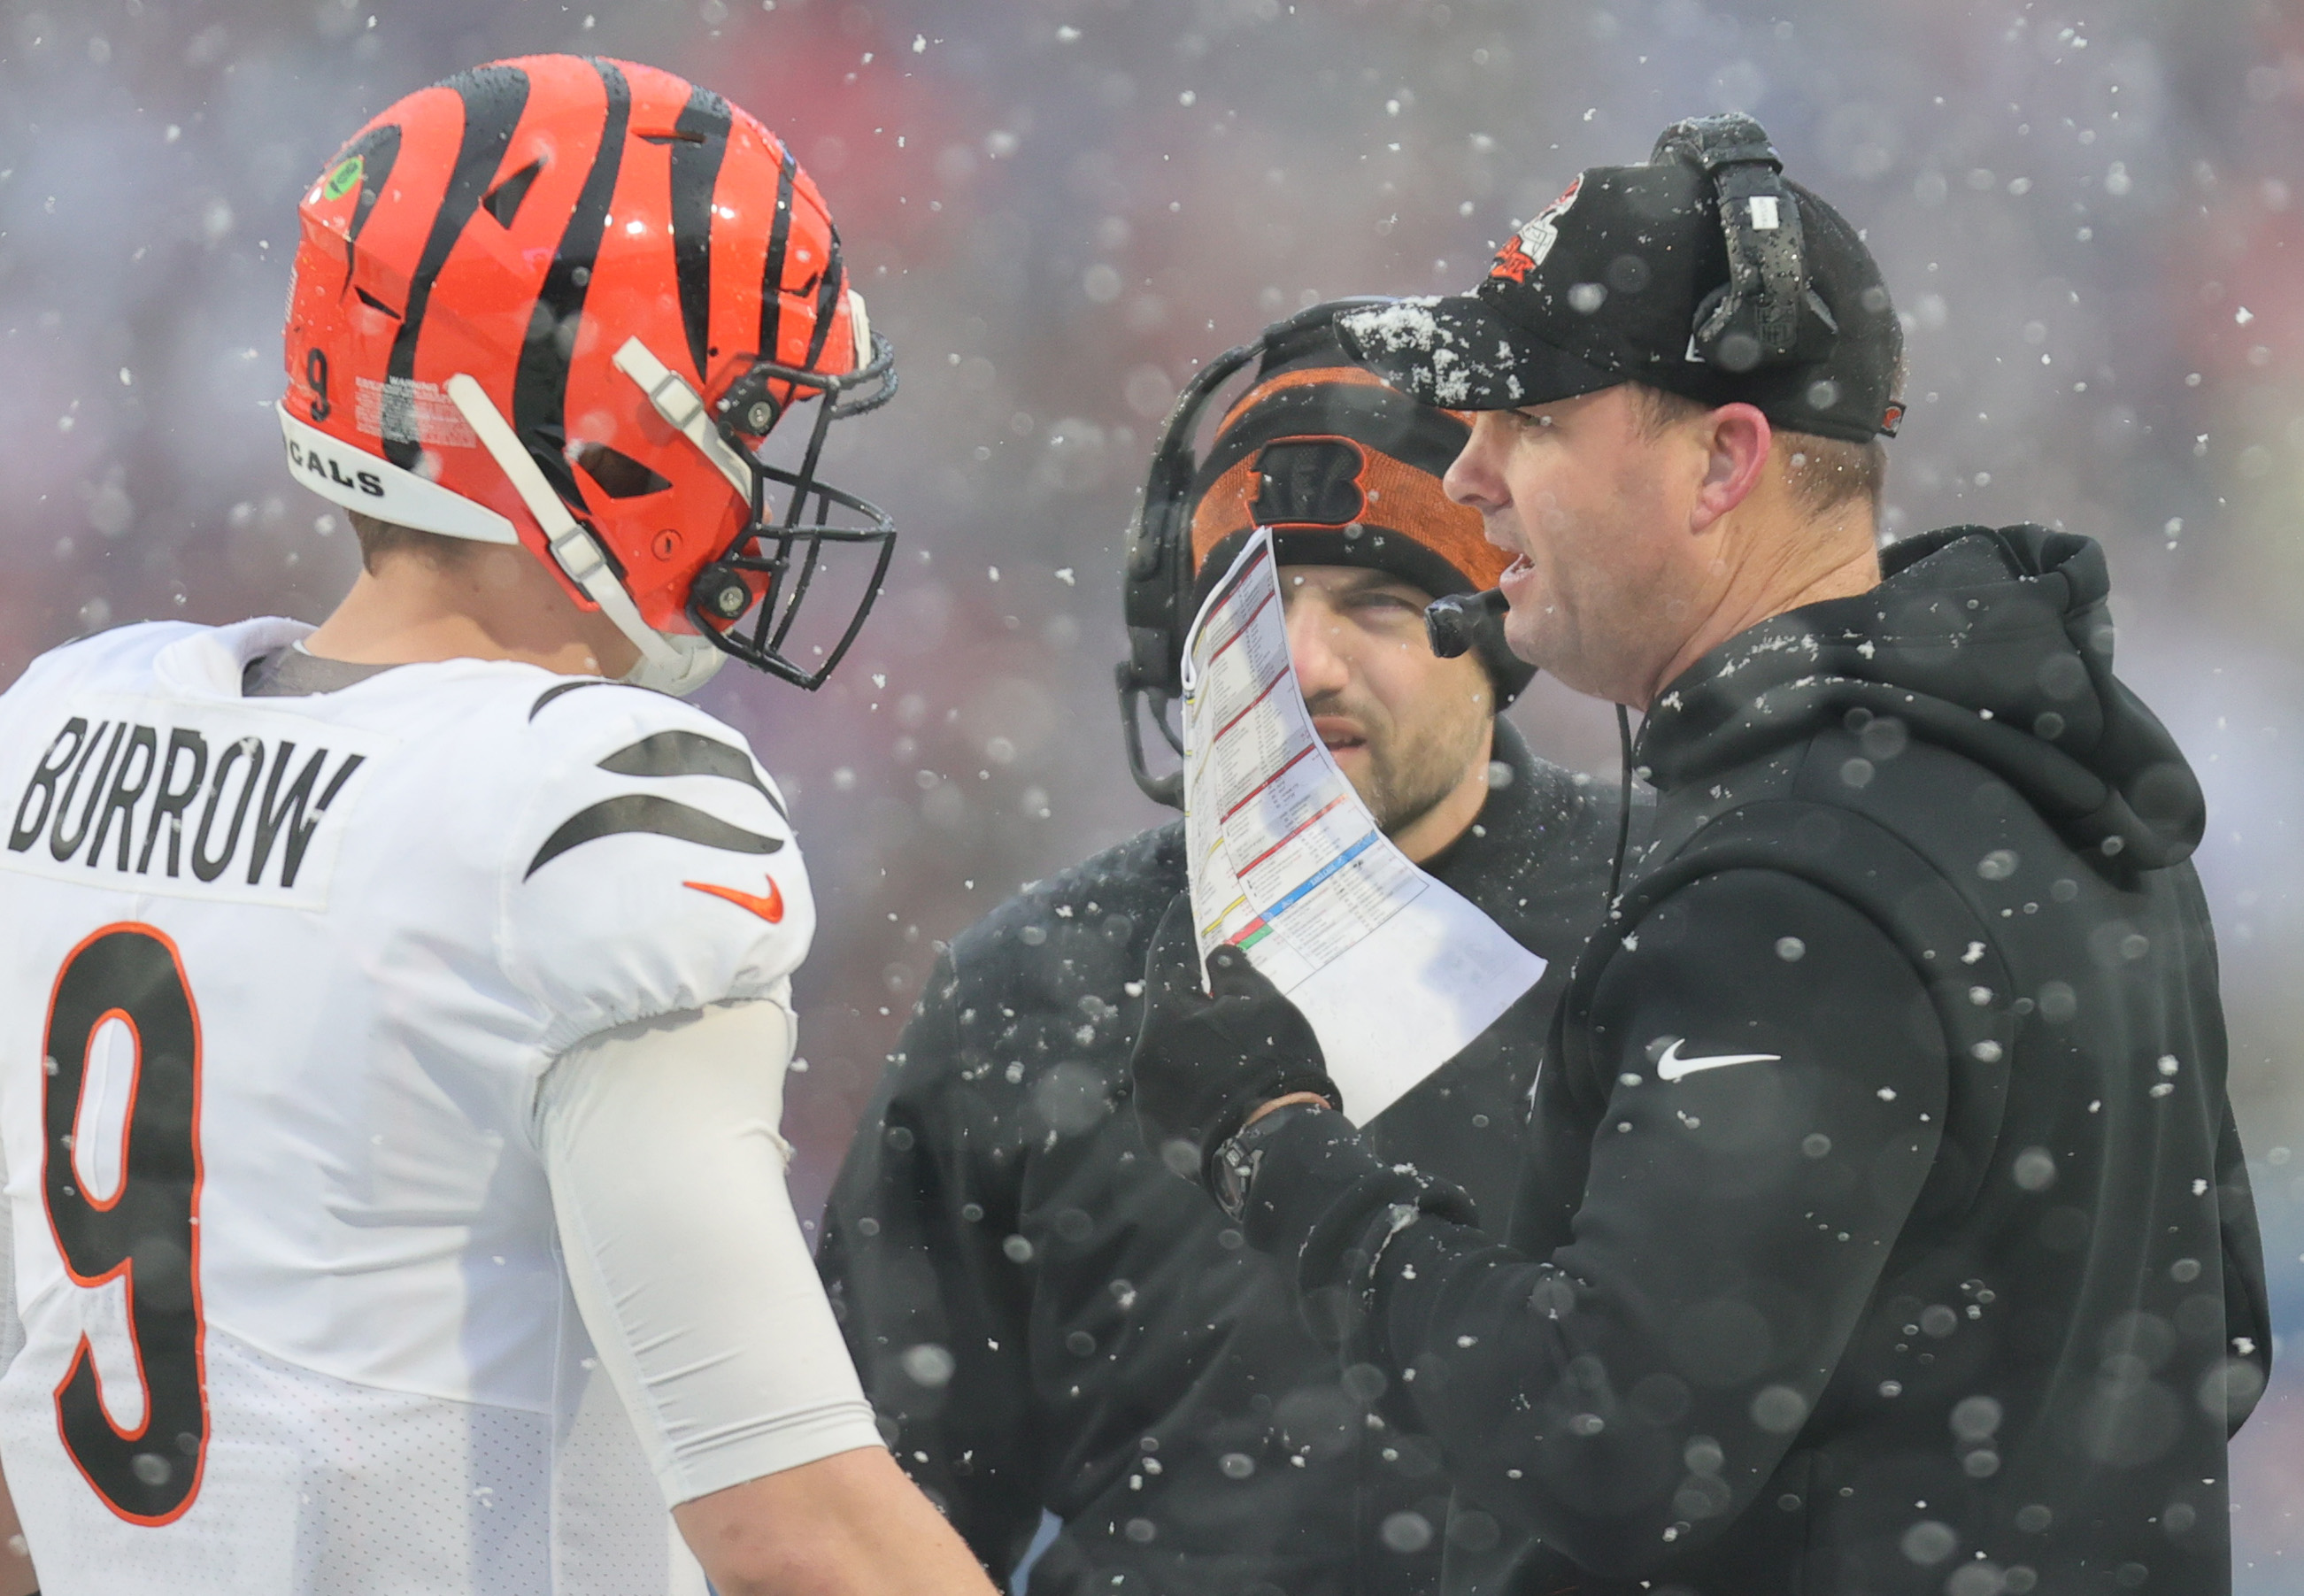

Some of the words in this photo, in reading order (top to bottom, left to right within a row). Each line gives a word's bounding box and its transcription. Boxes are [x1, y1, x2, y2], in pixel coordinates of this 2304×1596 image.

[307, 348, 330, 421] 9
[289, 440, 384, 497] GALS
[8, 717, 367, 888] BURROW
[42, 921, 209, 1526] 9
